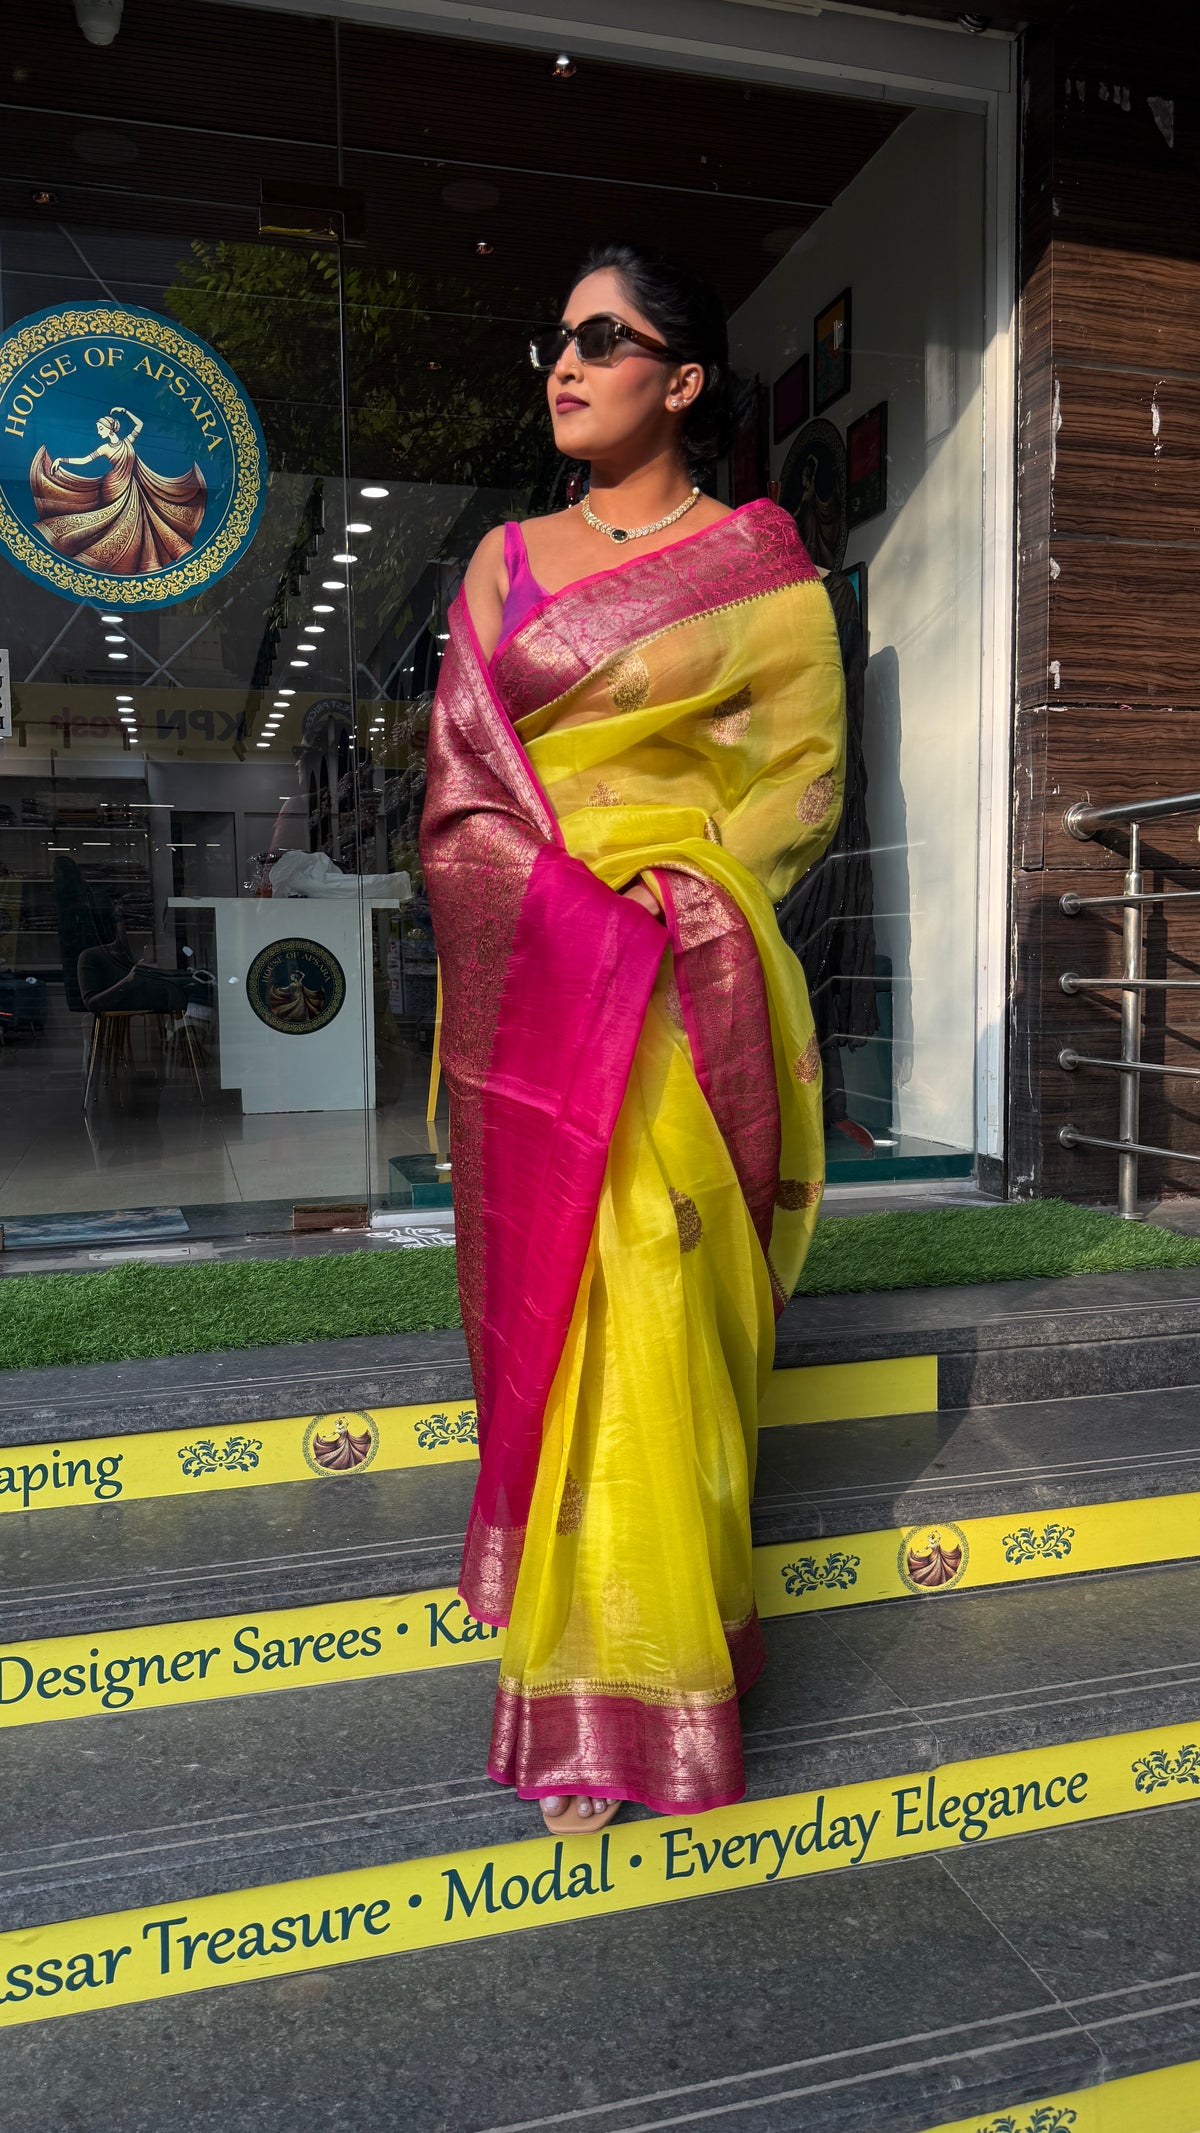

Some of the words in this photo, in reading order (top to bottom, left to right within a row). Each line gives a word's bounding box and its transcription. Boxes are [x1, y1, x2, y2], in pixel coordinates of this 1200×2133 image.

[5, 354, 77, 438] HOUSE
[83, 347, 125, 367] OF
[133, 355, 224, 452] APSARA
[261, 955, 283, 983] HOUSE
[285, 951, 299, 960] OF
[301, 953, 332, 982] APSARA
[0, 1449, 124, 1508] aping
[0, 1647, 221, 1709] Designer
[232, 1625, 383, 1674] Sarees
[0, 1945, 132, 2004] ssar
[142, 1898, 391, 1976] Treasure
[440, 1833, 615, 1922] Modal
[659, 1795, 881, 1880] Everyday
[891, 1770, 1089, 1843] Elegance
